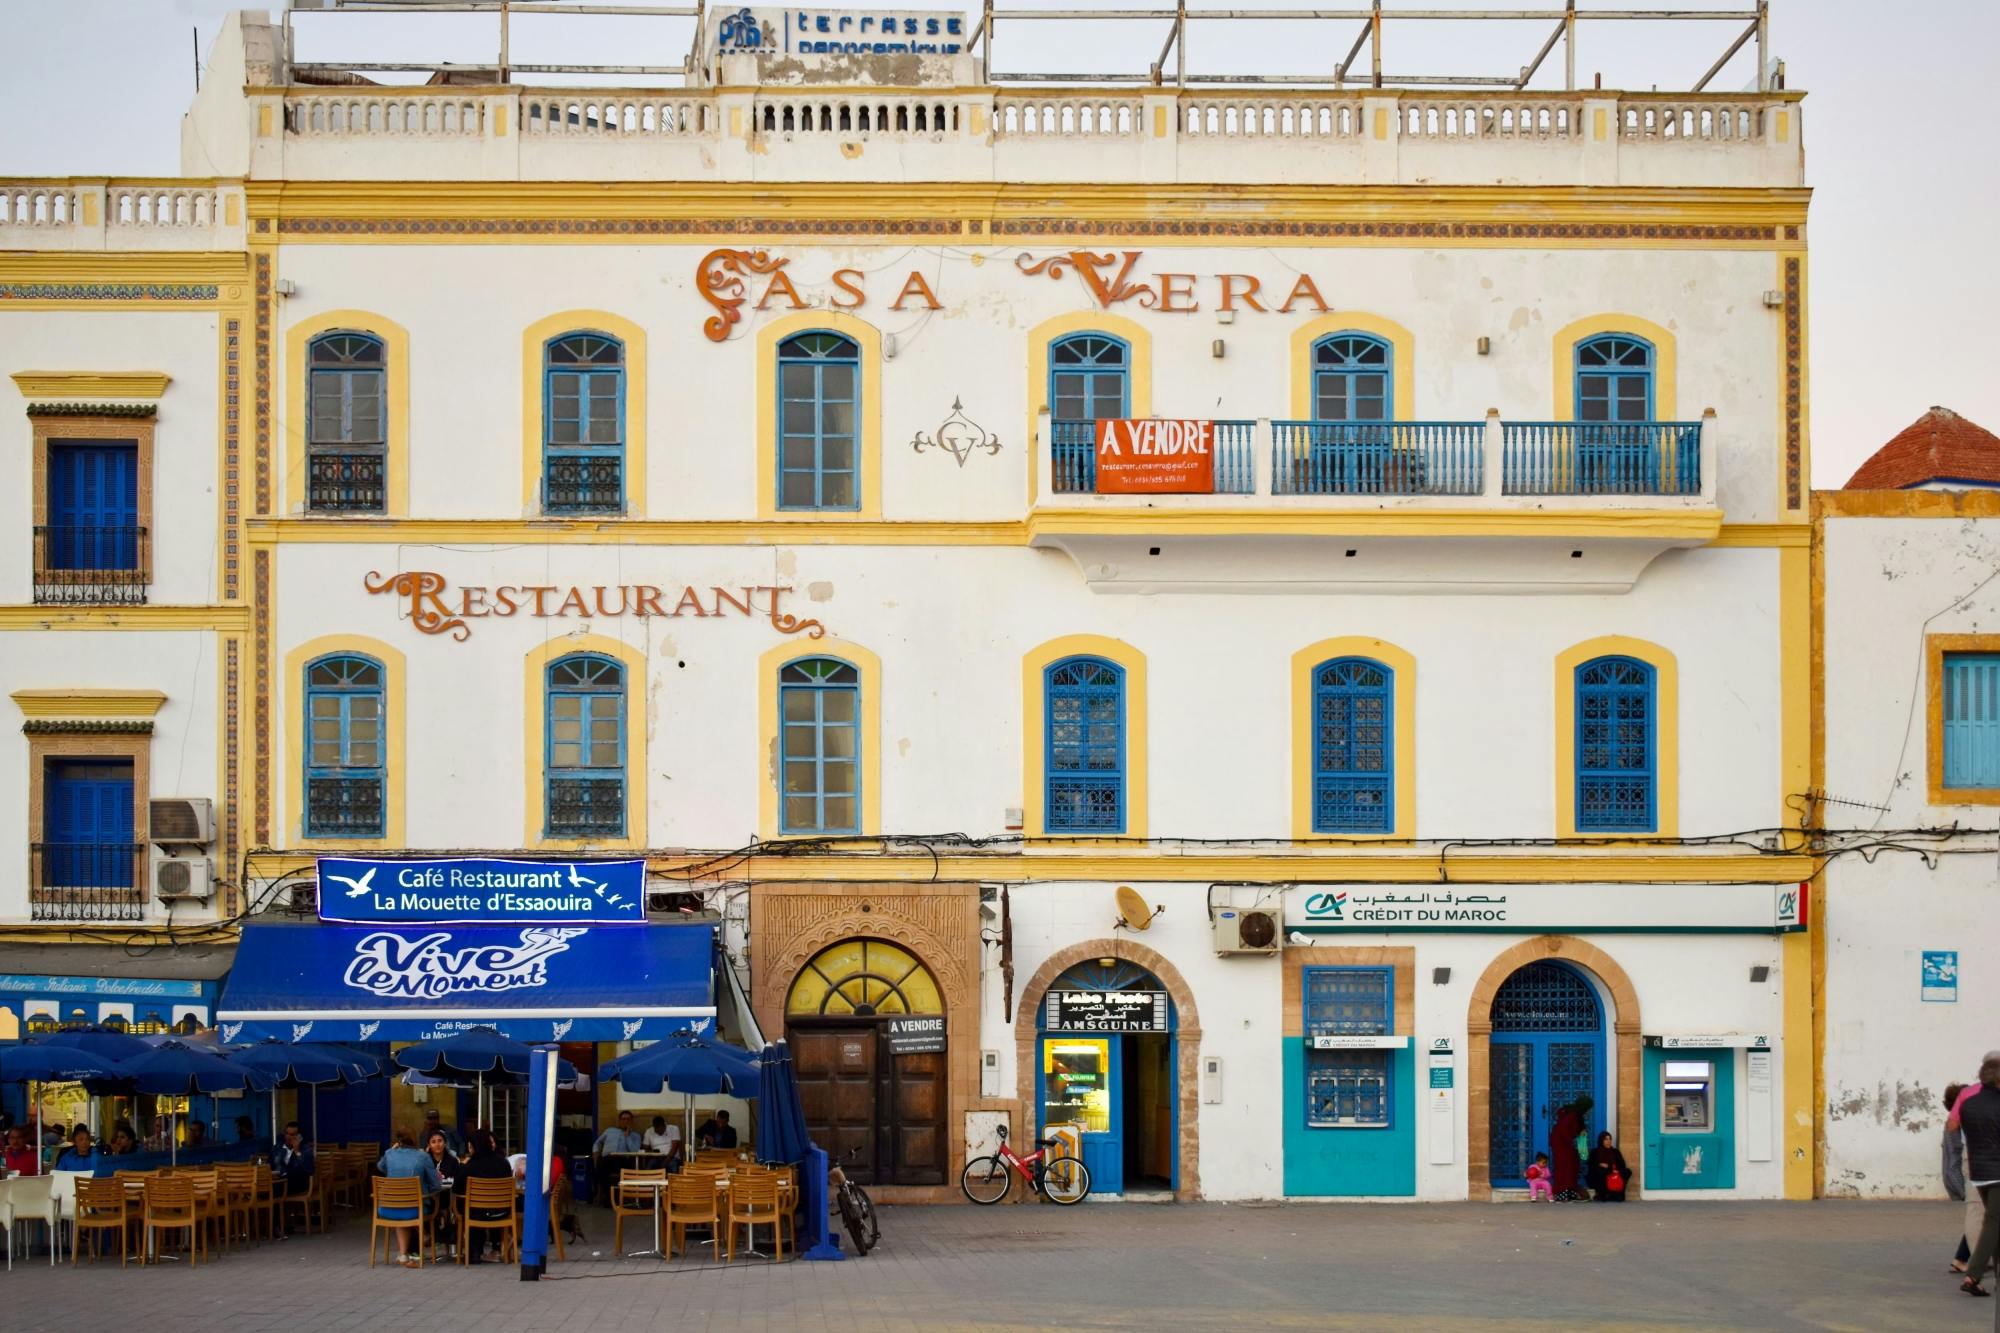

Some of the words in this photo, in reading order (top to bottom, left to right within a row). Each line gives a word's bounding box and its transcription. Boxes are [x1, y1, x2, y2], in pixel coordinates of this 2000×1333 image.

[696, 247, 943, 343] CASA
[1016, 250, 1335, 312] VERA
[1100, 421, 1121, 455] A
[1125, 421, 1210, 455] VENDRE
[364, 570, 825, 642] RESTAURANT
[398, 868, 444, 888] Café
[450, 869, 562, 888] Restaurant
[374, 894, 394, 911] La
[400, 893, 481, 911] Mouette
[487, 893, 592, 911] d'Essaouira
[1352, 892, 1430, 906] المغرب
[1433, 891, 1507, 906] مصرف
[1352, 908, 1413, 921] CRÉDIT
[1417, 910, 1440, 921] DU
[1444, 910, 1507, 921] MAROC
[359, 934, 545, 973] Vive
[349, 956, 394, 990] le
[394, 963, 546, 994] Moment
[435, 1021, 453, 1030] Café
[890, 1021, 898, 1033] A
[900, 1019, 942, 1032] VENDRE
[1061, 1020, 1151, 1030] AMSGUINE
[421, 1032, 431, 1040] La
